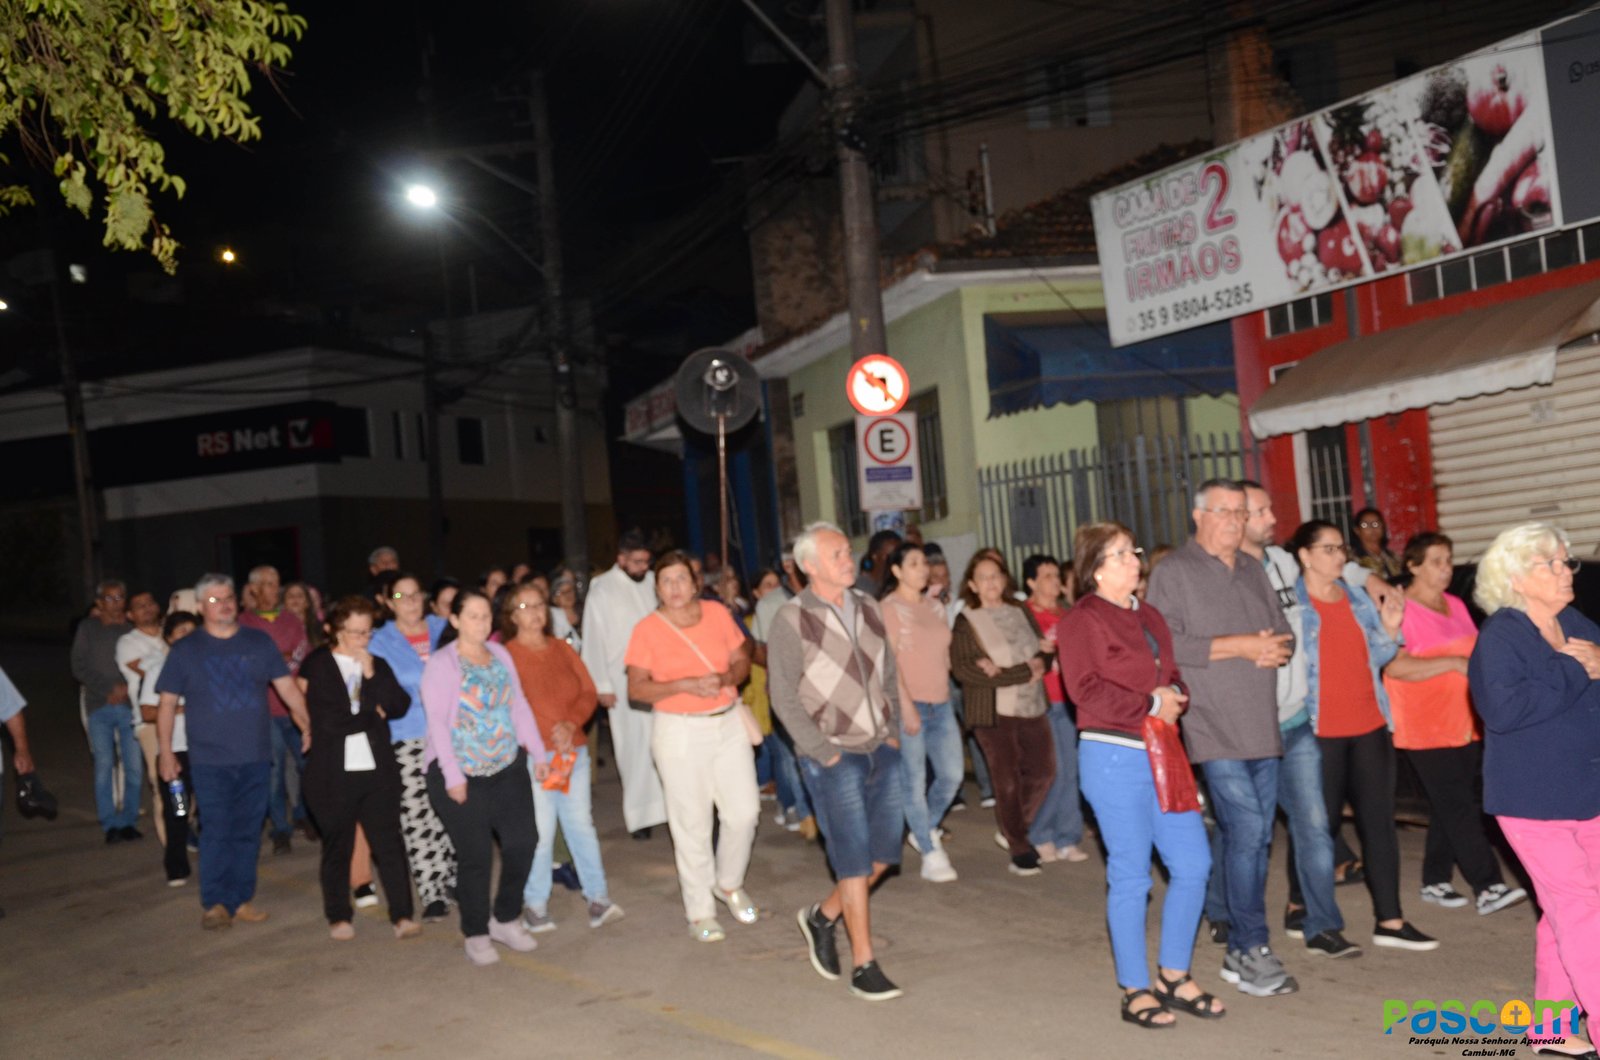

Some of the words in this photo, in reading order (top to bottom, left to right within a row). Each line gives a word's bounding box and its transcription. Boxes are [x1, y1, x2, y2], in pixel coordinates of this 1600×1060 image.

[1199, 161, 1237, 236] 2
[1138, 310, 1157, 331] 35
[1160, 306, 1170, 326] 9
[1173, 283, 1253, 322] 8804-5285
[197, 430, 231, 457] RS
[233, 425, 281, 452] Net
[879, 428, 895, 453] E
